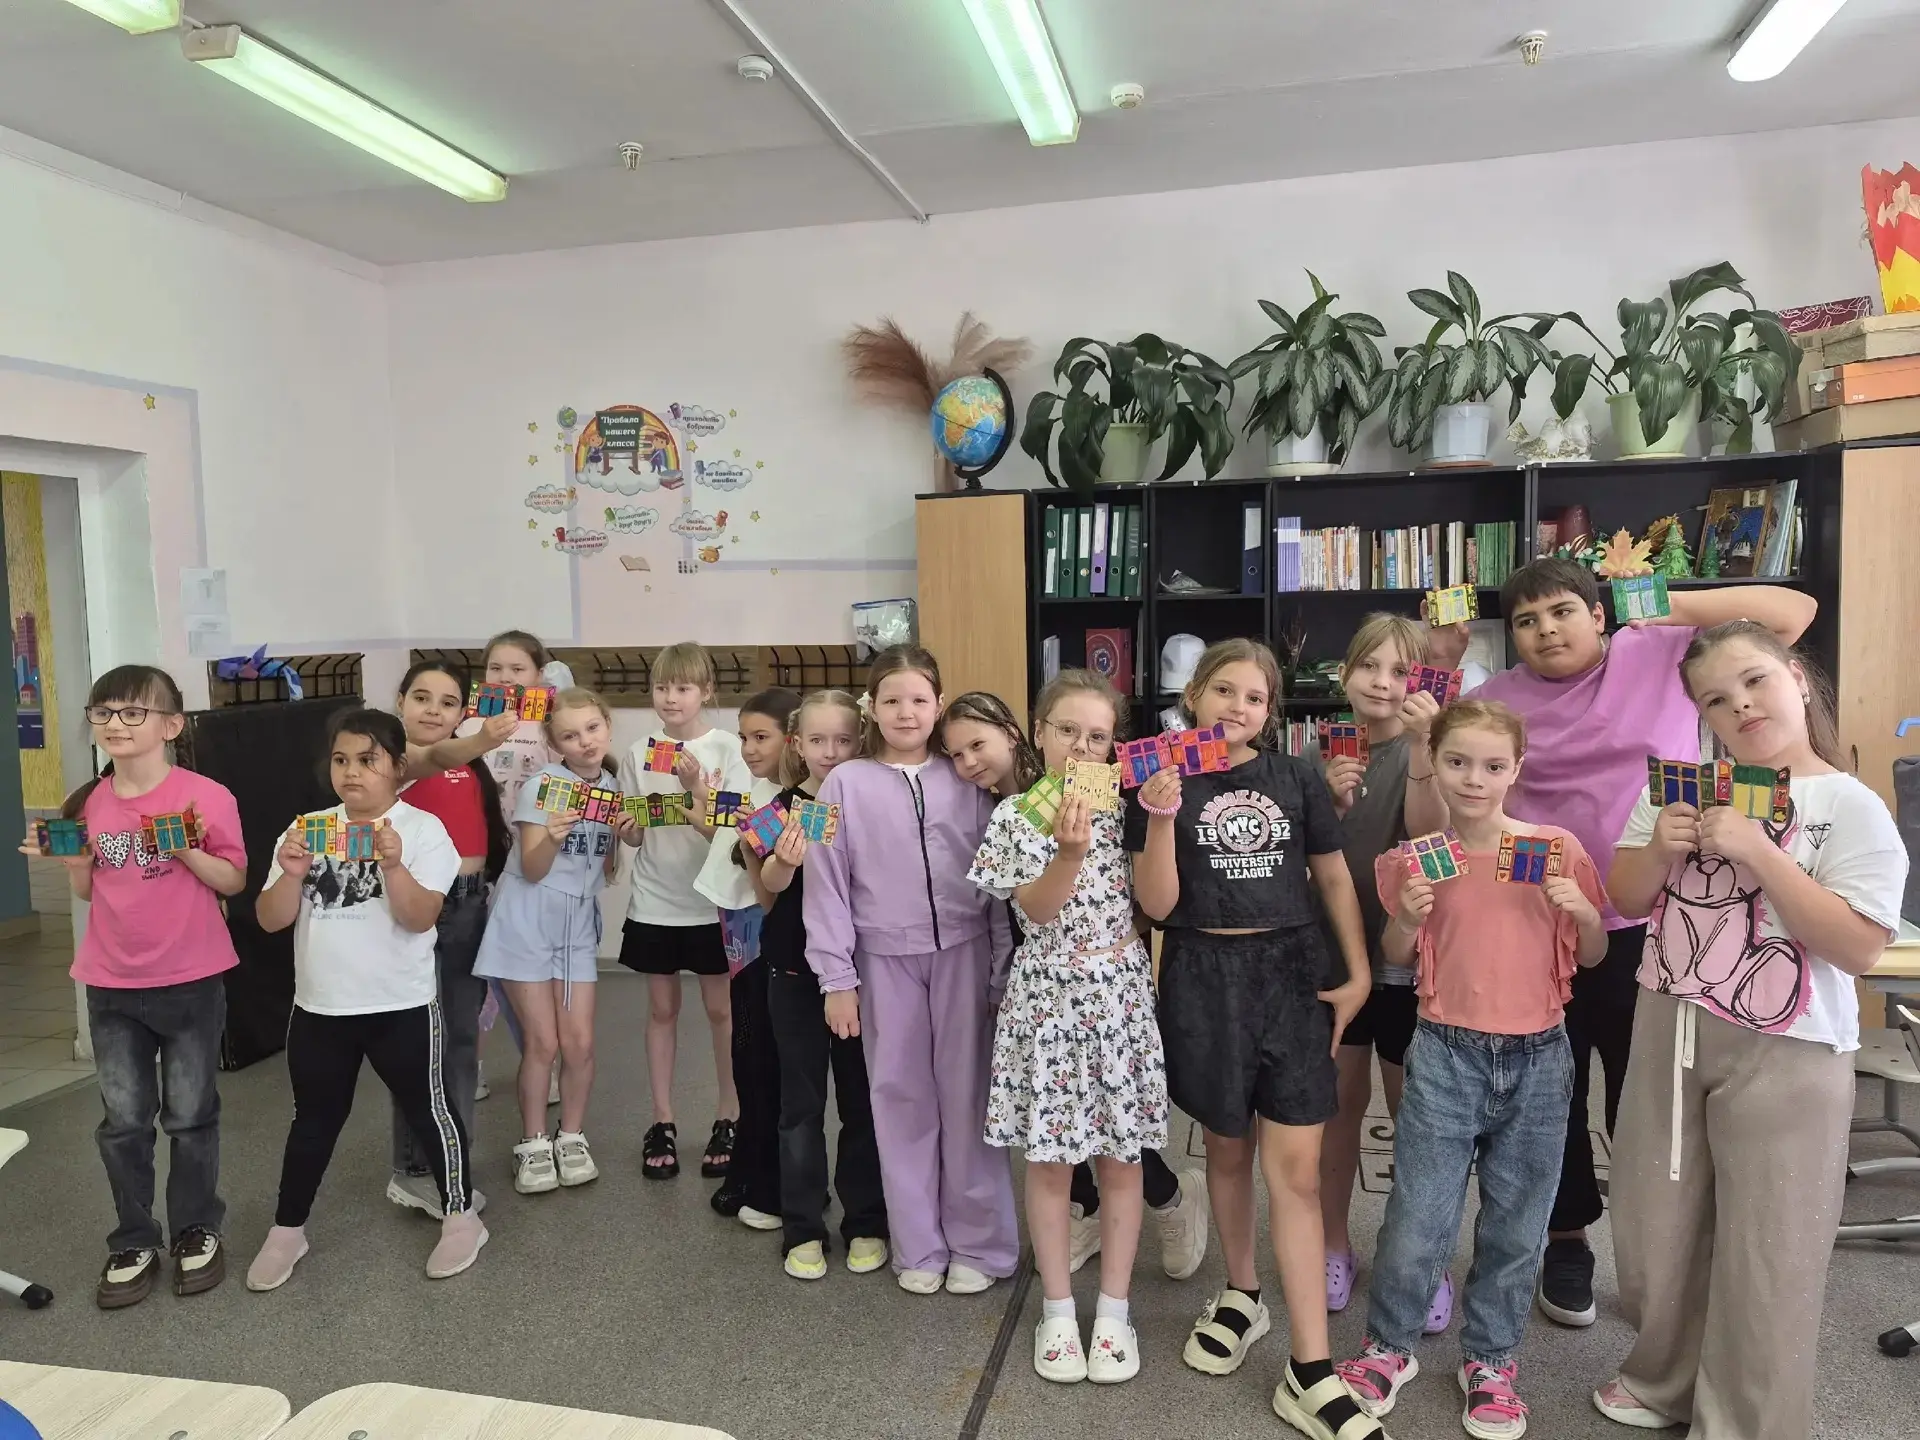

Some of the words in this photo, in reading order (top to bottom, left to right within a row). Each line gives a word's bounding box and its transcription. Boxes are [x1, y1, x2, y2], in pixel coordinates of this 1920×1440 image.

[1199, 789, 1284, 825] BROOKLYN
[1197, 828, 1218, 842] 19
[1226, 816, 1261, 837] NYC
[1270, 823, 1291, 837] 92
[1210, 855, 1284, 869] UNIVERSITY
[1226, 867, 1274, 879] LEAGUE
